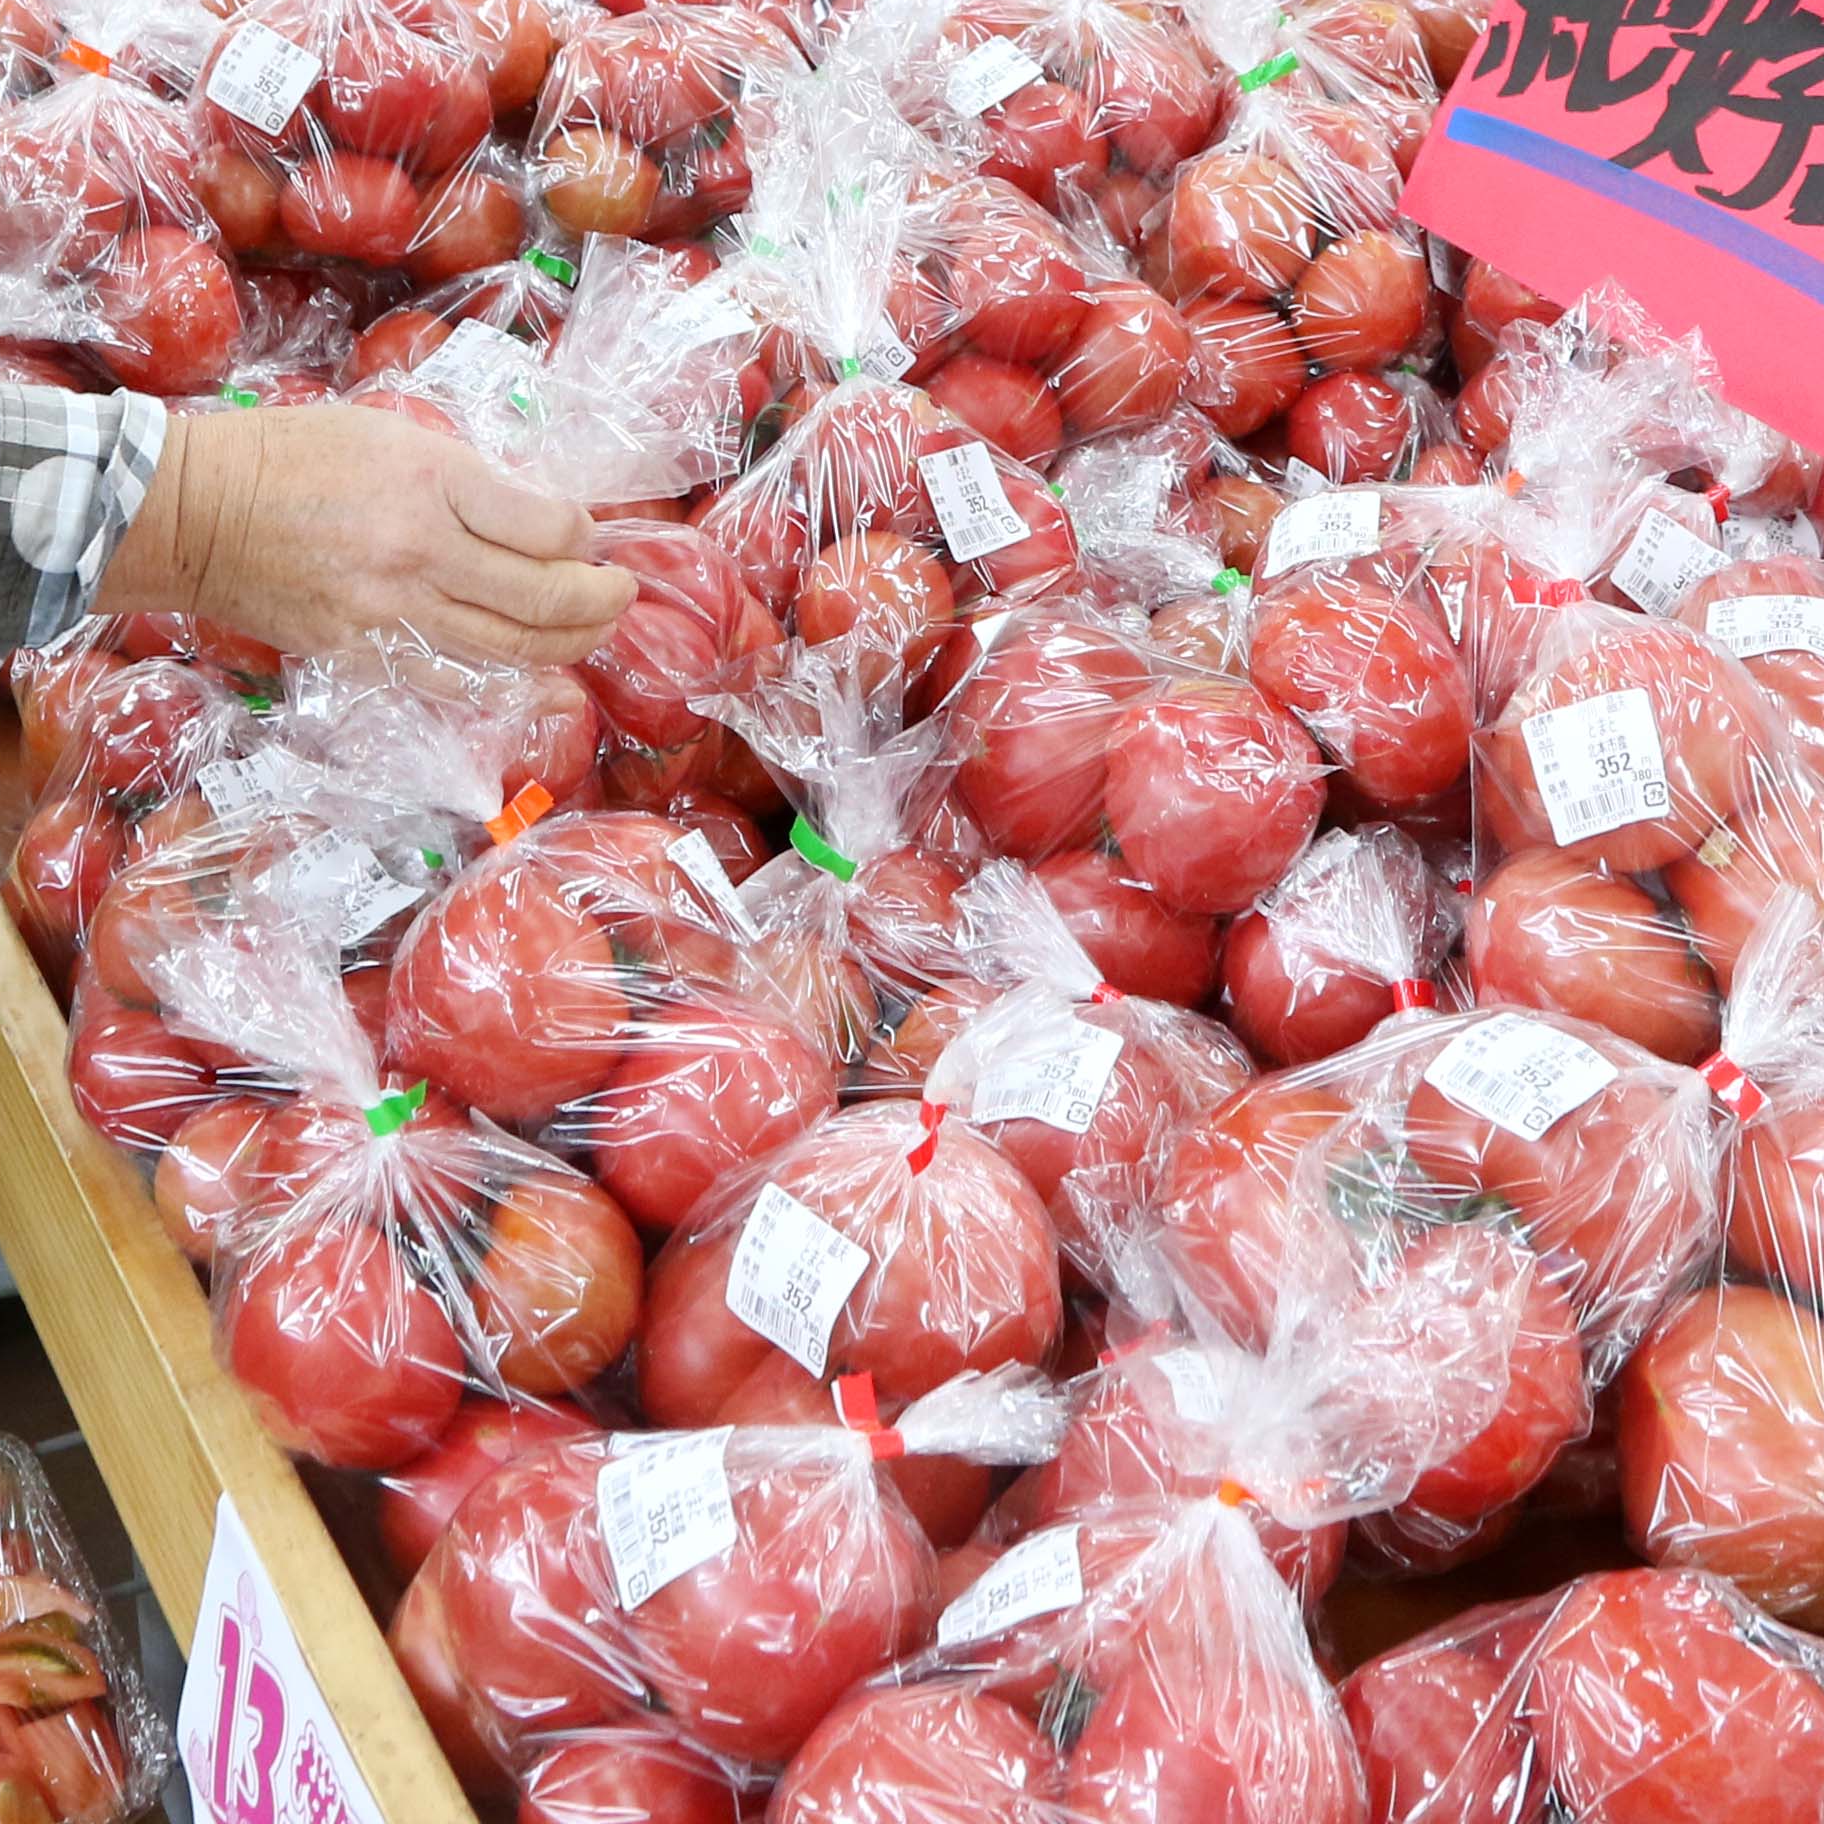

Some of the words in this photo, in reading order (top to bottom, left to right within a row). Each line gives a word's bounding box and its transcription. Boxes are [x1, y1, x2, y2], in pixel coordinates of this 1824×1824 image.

[254, 75, 281, 98] 352
[966, 495, 990, 515] 352
[1319, 521, 1352, 533] 352
[1769, 619, 1804, 629] 352
[1588, 718, 1618, 739] とまと
[1587, 735, 1628, 759] 北本市産
[1595, 751, 1633, 779] 352
[1631, 768, 1652, 782] 380
[1037, 1062, 1077, 1082] 352
[1513, 1063, 1553, 1092] 352
[781, 1280, 813, 1314] 352
[647, 1503, 670, 1547] 352
